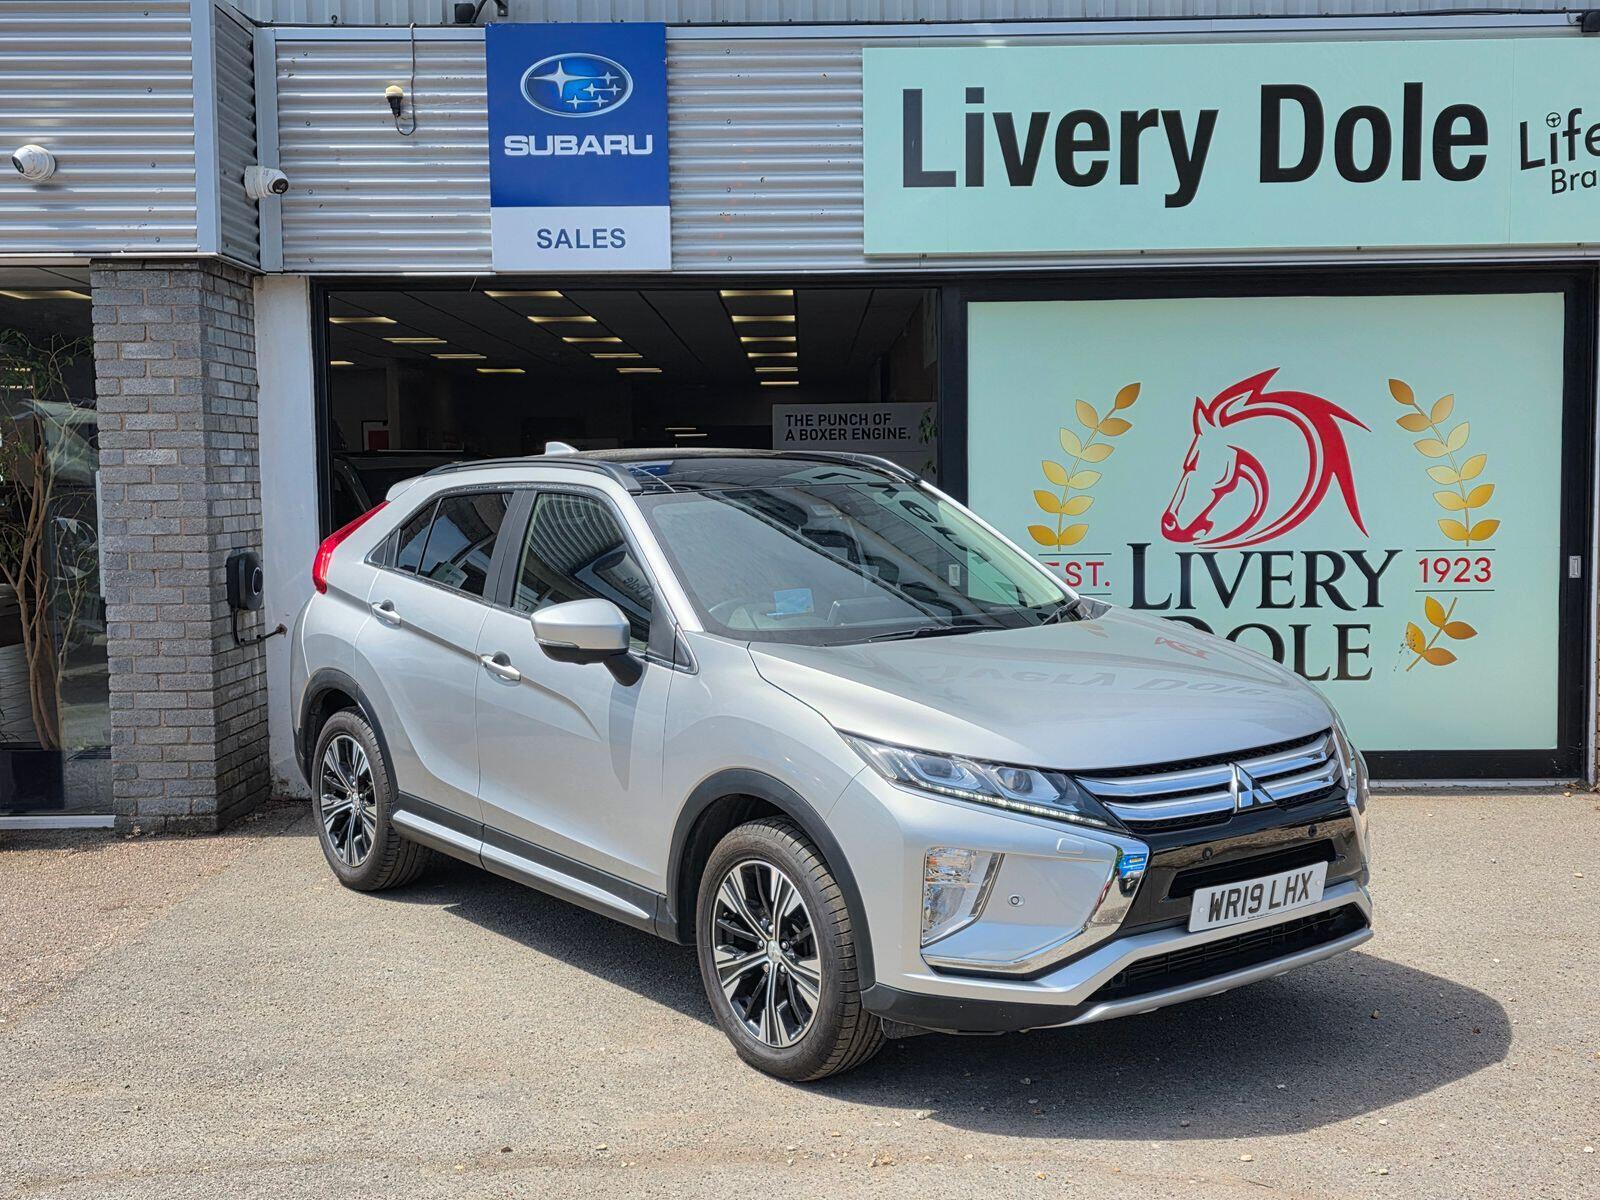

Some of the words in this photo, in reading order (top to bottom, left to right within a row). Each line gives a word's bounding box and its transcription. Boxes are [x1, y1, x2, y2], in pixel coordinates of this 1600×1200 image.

[504, 133, 653, 157] SUBARU
[902, 86, 1219, 208] Livery
[1259, 81, 1488, 183] Dole
[536, 227, 627, 250] SALES
[784, 429, 796, 442] A
[799, 428, 848, 442] BOXER
[852, 426, 912, 440] ENGINE.
[785, 414, 814, 428] THE
[818, 413, 868, 427] PUNCH
[872, 412, 892, 425] OF
[1044, 560, 1111, 588] ST.
[1126, 542, 1403, 612] LIVERY
[1418, 556, 1493, 584] 1923
[1160, 615, 1374, 682] OLE
[1208, 883, 1265, 923] WR19
[1268, 870, 1313, 910] LHX
